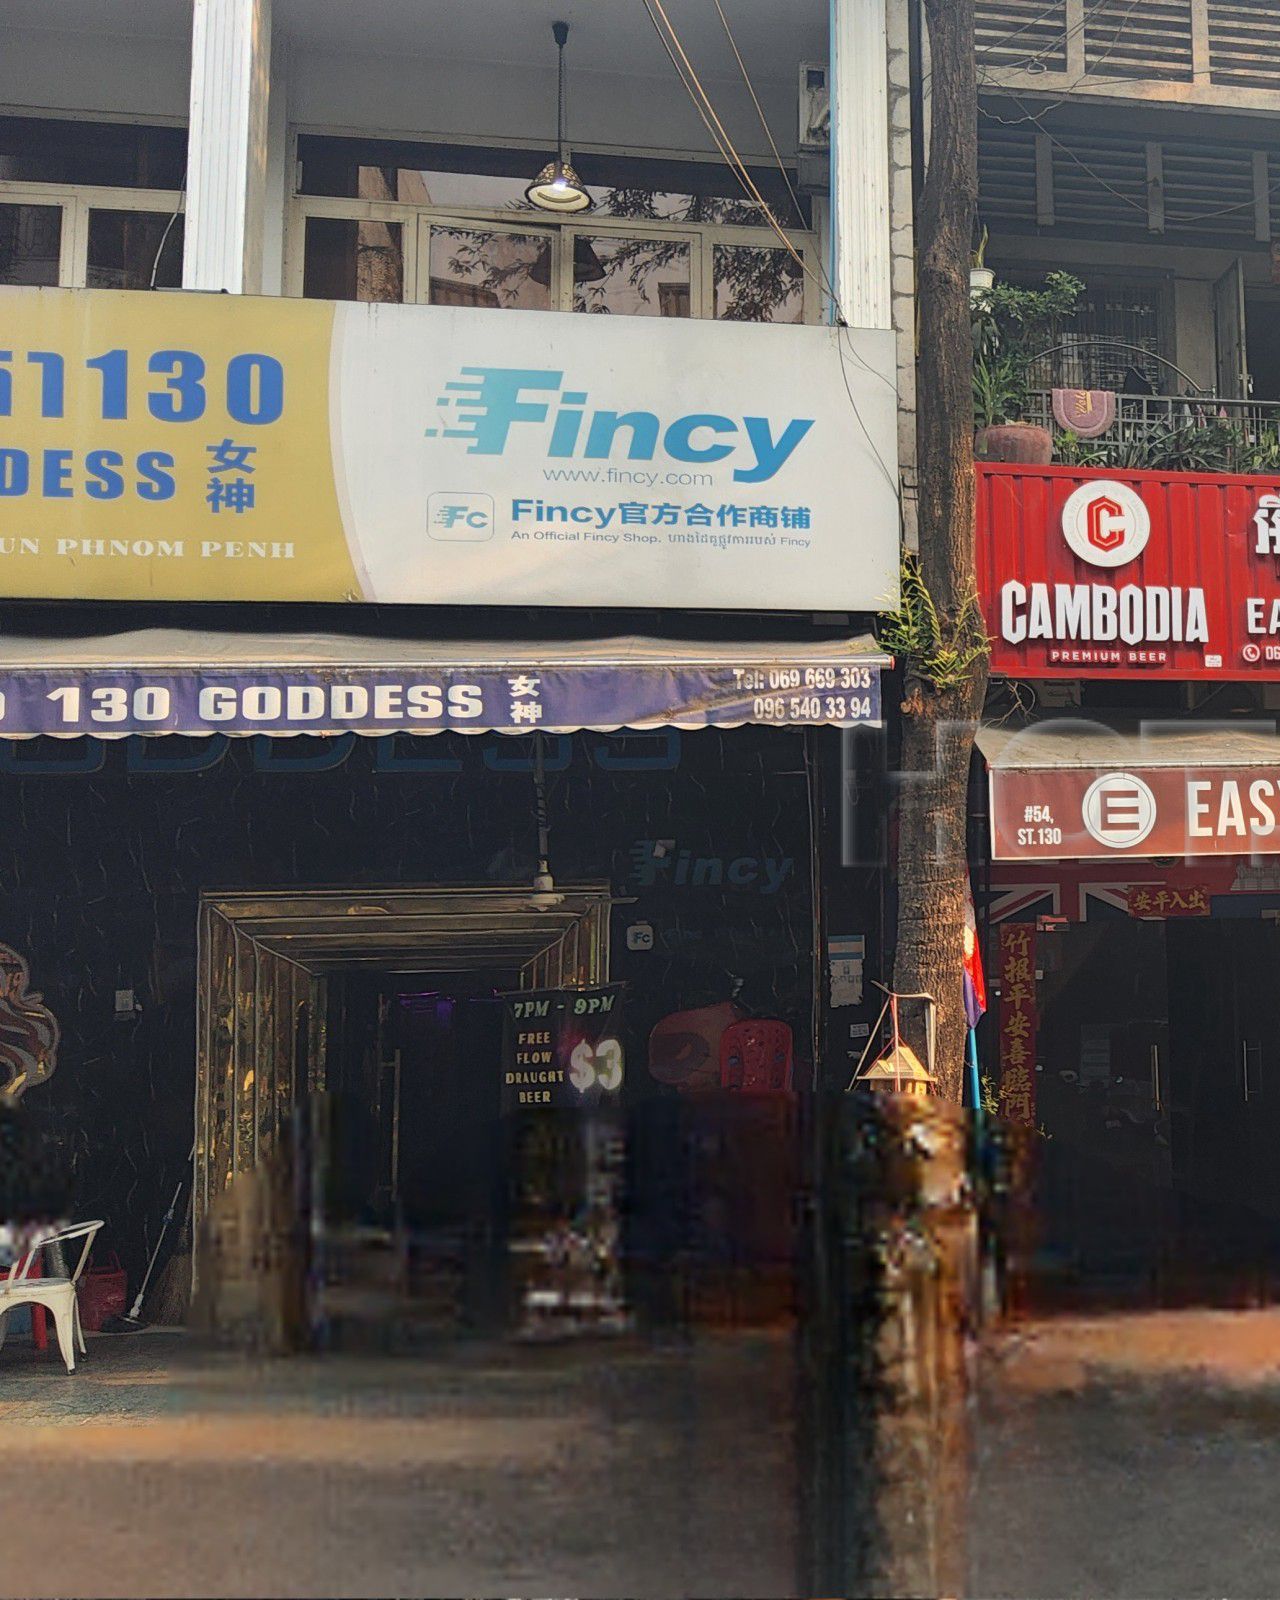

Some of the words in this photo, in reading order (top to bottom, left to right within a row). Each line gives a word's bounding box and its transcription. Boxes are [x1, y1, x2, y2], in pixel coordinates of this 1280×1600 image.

[424, 366, 816, 484] Fincy
[0, 448, 176, 500] DESS
[206, 438, 257, 514] 女神
[543, 467, 714, 488] www.fincy.com
[510, 498, 812, 530] Fincy官方合作商铺
[57, 538, 184, 557] PHNOM
[201, 540, 296, 559] PENH
[510, 530, 530, 540] An
[533, 530, 580, 542] Official
[583, 532, 620, 544] Fincy
[622, 532, 662, 545] Shop.
[780, 536, 811, 549] Fincy
[1001, 579, 1209, 646] CAMBODIA
[1051, 649, 1121, 663] PREMIUM
[1128, 650, 1167, 663] BEER
[733, 668, 764, 690] Tel:
[769, 669, 800, 690] 069
[804, 668, 836, 689] 669
[840, 668, 871, 689] 303
[46, 686, 170, 722] 130
[199, 684, 483, 721] GODDESS
[508, 675, 543, 724] 女神
[753, 697, 785, 719] 096
[788, 697, 822, 719] 540
[825, 697, 847, 718] 33
[850, 697, 871, 718] 94
[1023, 804, 1054, 825] #54,
[1017, 827, 1062, 846] ST.130
[628, 838, 795, 894] Fincy
[513, 999, 551, 1018] 7PM
[573, 994, 616, 1016] 9PM
[517, 1031, 551, 1046] FREE
[516, 1051, 553, 1065] FLOW
[569, 1037, 623, 1094] $3
[505, 1070, 565, 1085] DRAUGHT
[518, 1090, 551, 1104] BEER
